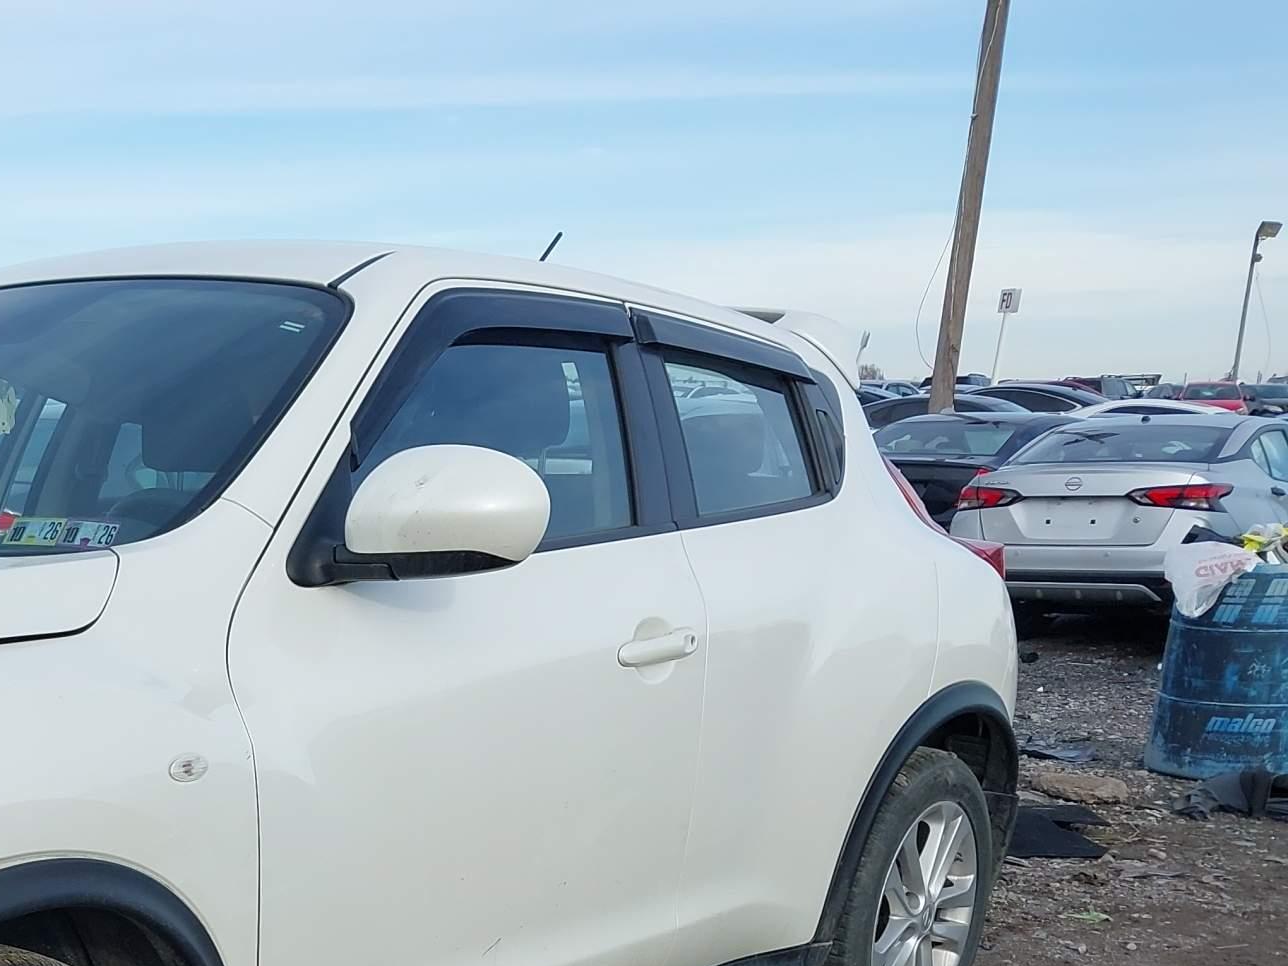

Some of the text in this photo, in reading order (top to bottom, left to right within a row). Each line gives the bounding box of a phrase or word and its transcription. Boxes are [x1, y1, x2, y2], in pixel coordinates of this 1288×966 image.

[10, 521, 62, 542] 10 26
[63, 525, 117, 545] 10 26
[1206, 713, 1276, 733] malco
